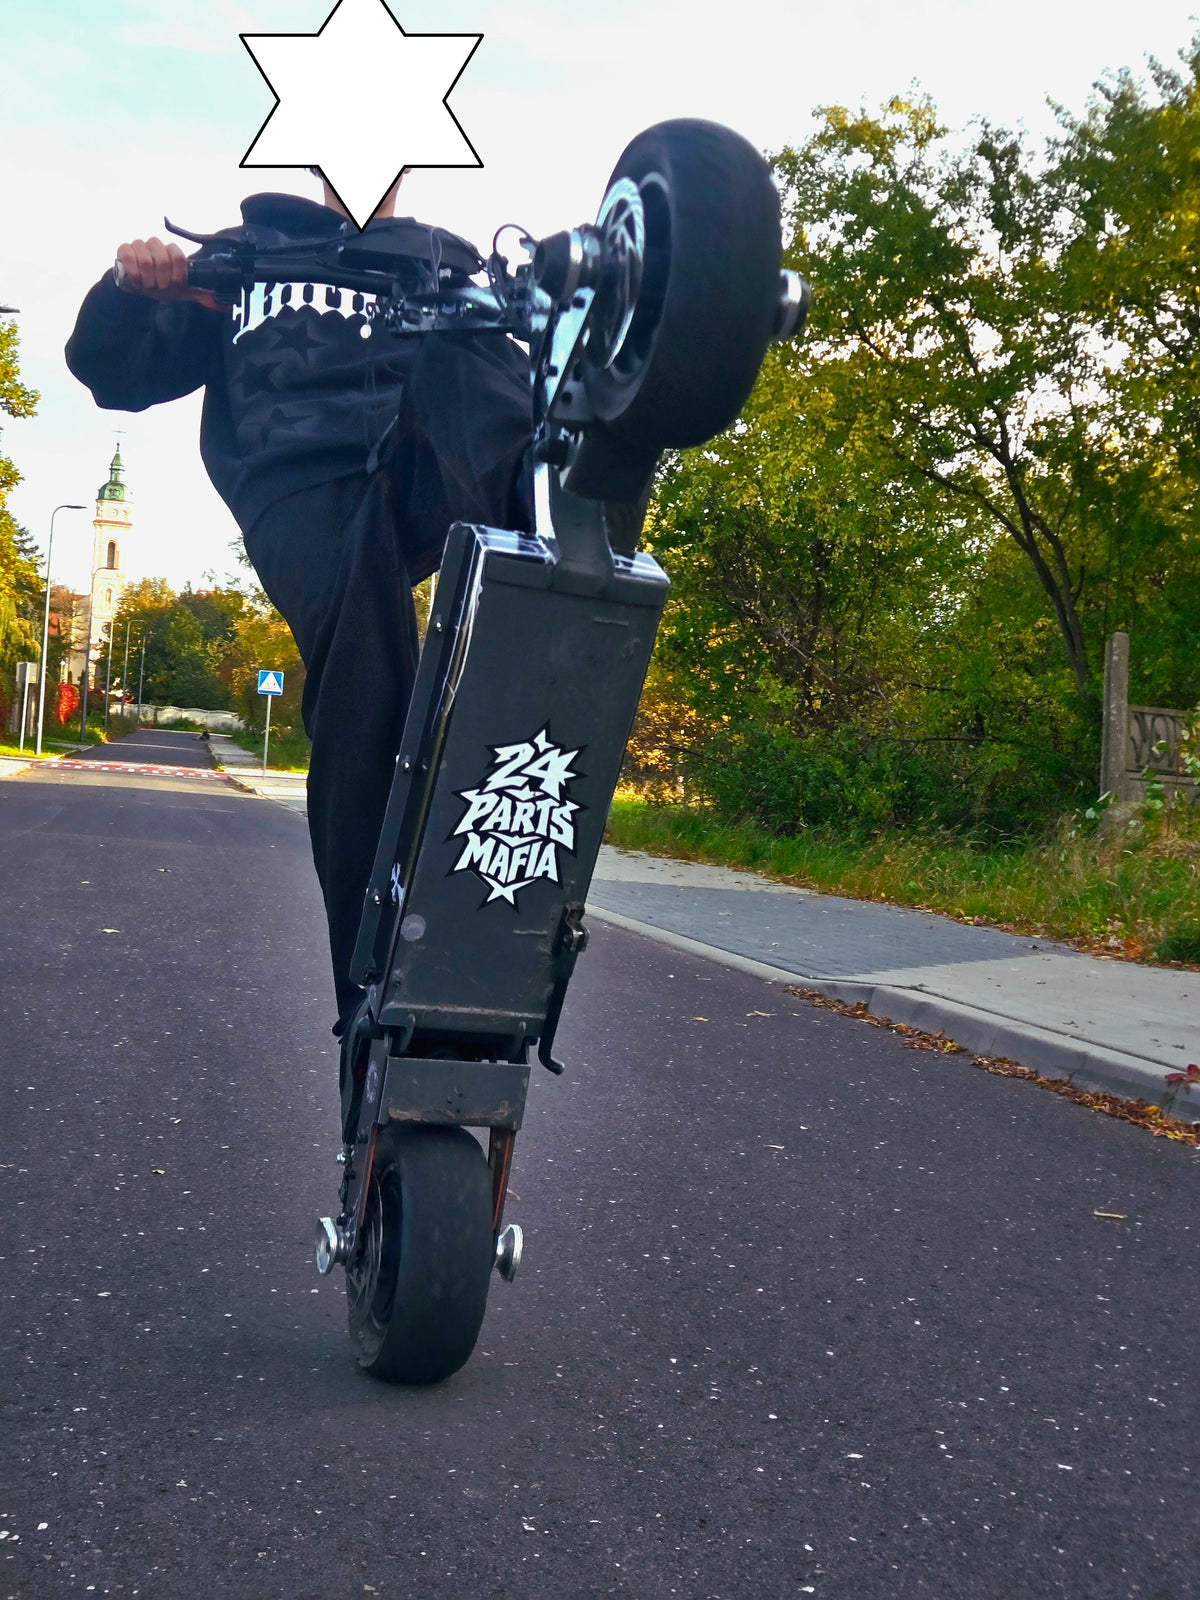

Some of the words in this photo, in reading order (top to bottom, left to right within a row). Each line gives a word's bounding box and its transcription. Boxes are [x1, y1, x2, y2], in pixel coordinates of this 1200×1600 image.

[483, 742, 579, 801] 24
[453, 789, 580, 850] PARTS
[453, 832, 559, 884] MAFIA
